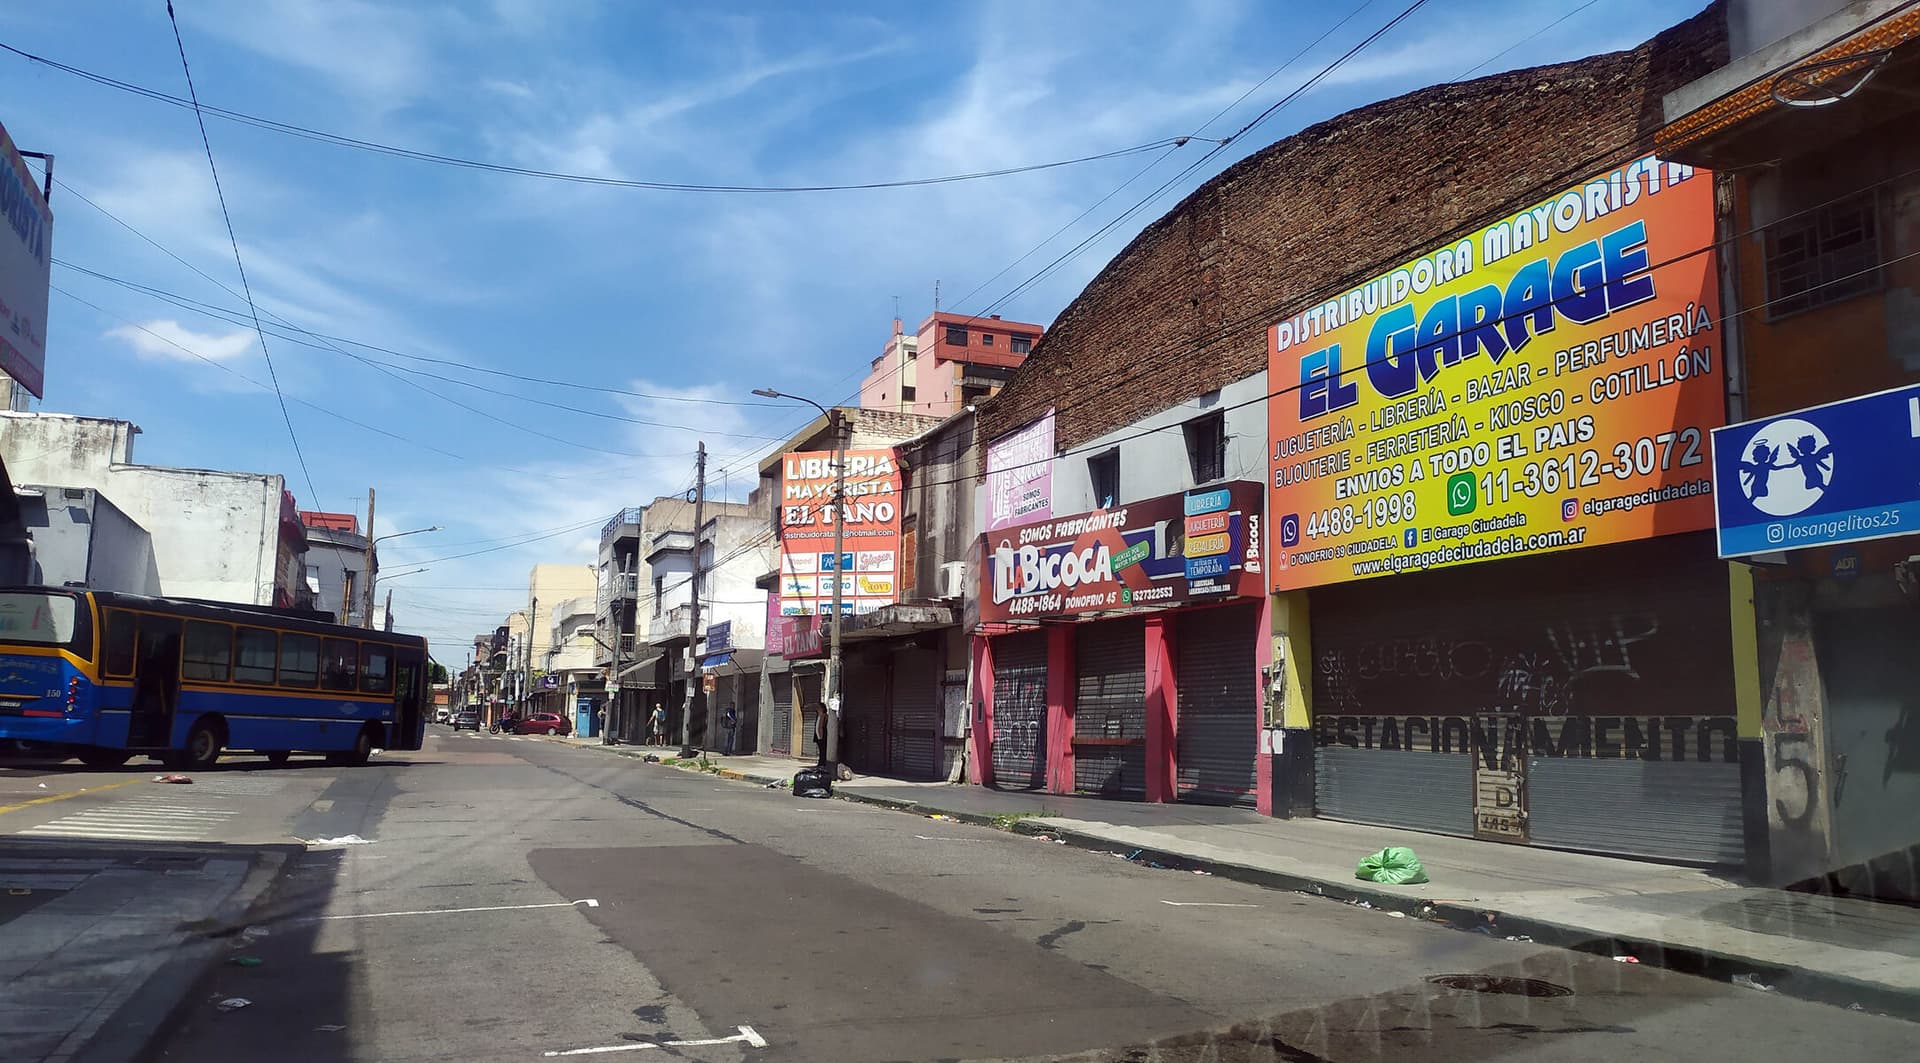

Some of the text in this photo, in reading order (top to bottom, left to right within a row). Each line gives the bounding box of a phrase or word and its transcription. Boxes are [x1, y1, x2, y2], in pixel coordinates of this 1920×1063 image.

[1277, 154, 1695, 352] DISTRIBUIDORA MAYORISTA
[1299, 219, 1657, 421] EL GARAGE
[1273, 419, 1355, 461] JUGUETERÍA
[1370, 387, 1447, 432] LIBRERÍA
[1466, 363, 1531, 401] BAZAR
[1554, 304, 1712, 376] PERFUMERÍA
[1274, 449, 1351, 489] BIJOUTERIE
[1366, 412, 1469, 464] FERRETERÍA
[1489, 388, 1565, 432] KIOSCO
[1590, 346, 1712, 402] COTILLÓN
[1335, 415, 1595, 500] ENVIOS A TODO EL PAIS
[1480, 427, 1703, 506] 11-3612-3072
[784, 502, 895, 525] EL TANO
[1305, 491, 1416, 540] 4488-1998
[1583, 479, 1712, 516] elgarageciudadela
[1019, 509, 1128, 545] SOMOS FABRICANTES
[1421, 513, 1527, 544] El Garage Ciudadela
[1788, 510, 1900, 539] losangelitos25
[1335, 546, 1346, 558] 39
[1346, 536, 1398, 556] CIUDADELA
[1352, 525, 1587, 577] www.elgaragedeciudadela.com.ar
[1835, 557, 1857, 570] ADT
[1009, 594, 1062, 615] 4488-1864
[1065, 594, 1104, 609] DONOFRIO
[1106, 592, 1117, 604] 45
[46, 689, 61, 698] 150
[1314, 712, 1739, 768] ESTACIONAMIENTO
